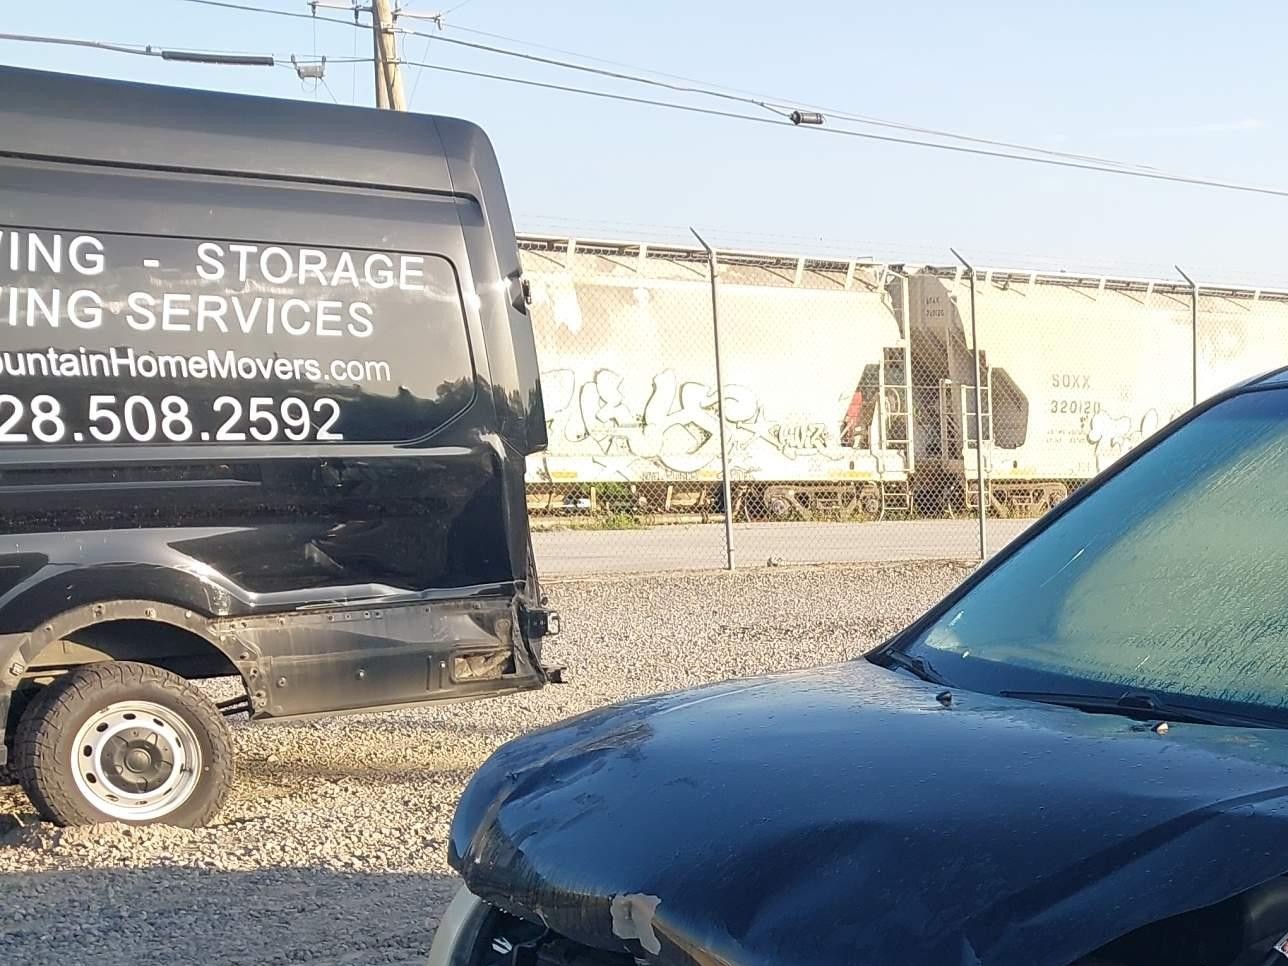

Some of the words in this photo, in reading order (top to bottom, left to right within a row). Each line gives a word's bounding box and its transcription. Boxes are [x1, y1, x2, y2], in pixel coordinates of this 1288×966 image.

[0, 231, 104, 275] ING
[143, 259, 160, 268] -
[196, 242, 425, 291] STORAGE
[0, 287, 103, 329] ING
[126, 291, 374, 337] SERVICES
[0, 347, 390, 382] untainHomeMovers.com
[0, 394, 343, 442] 28.508.2592
